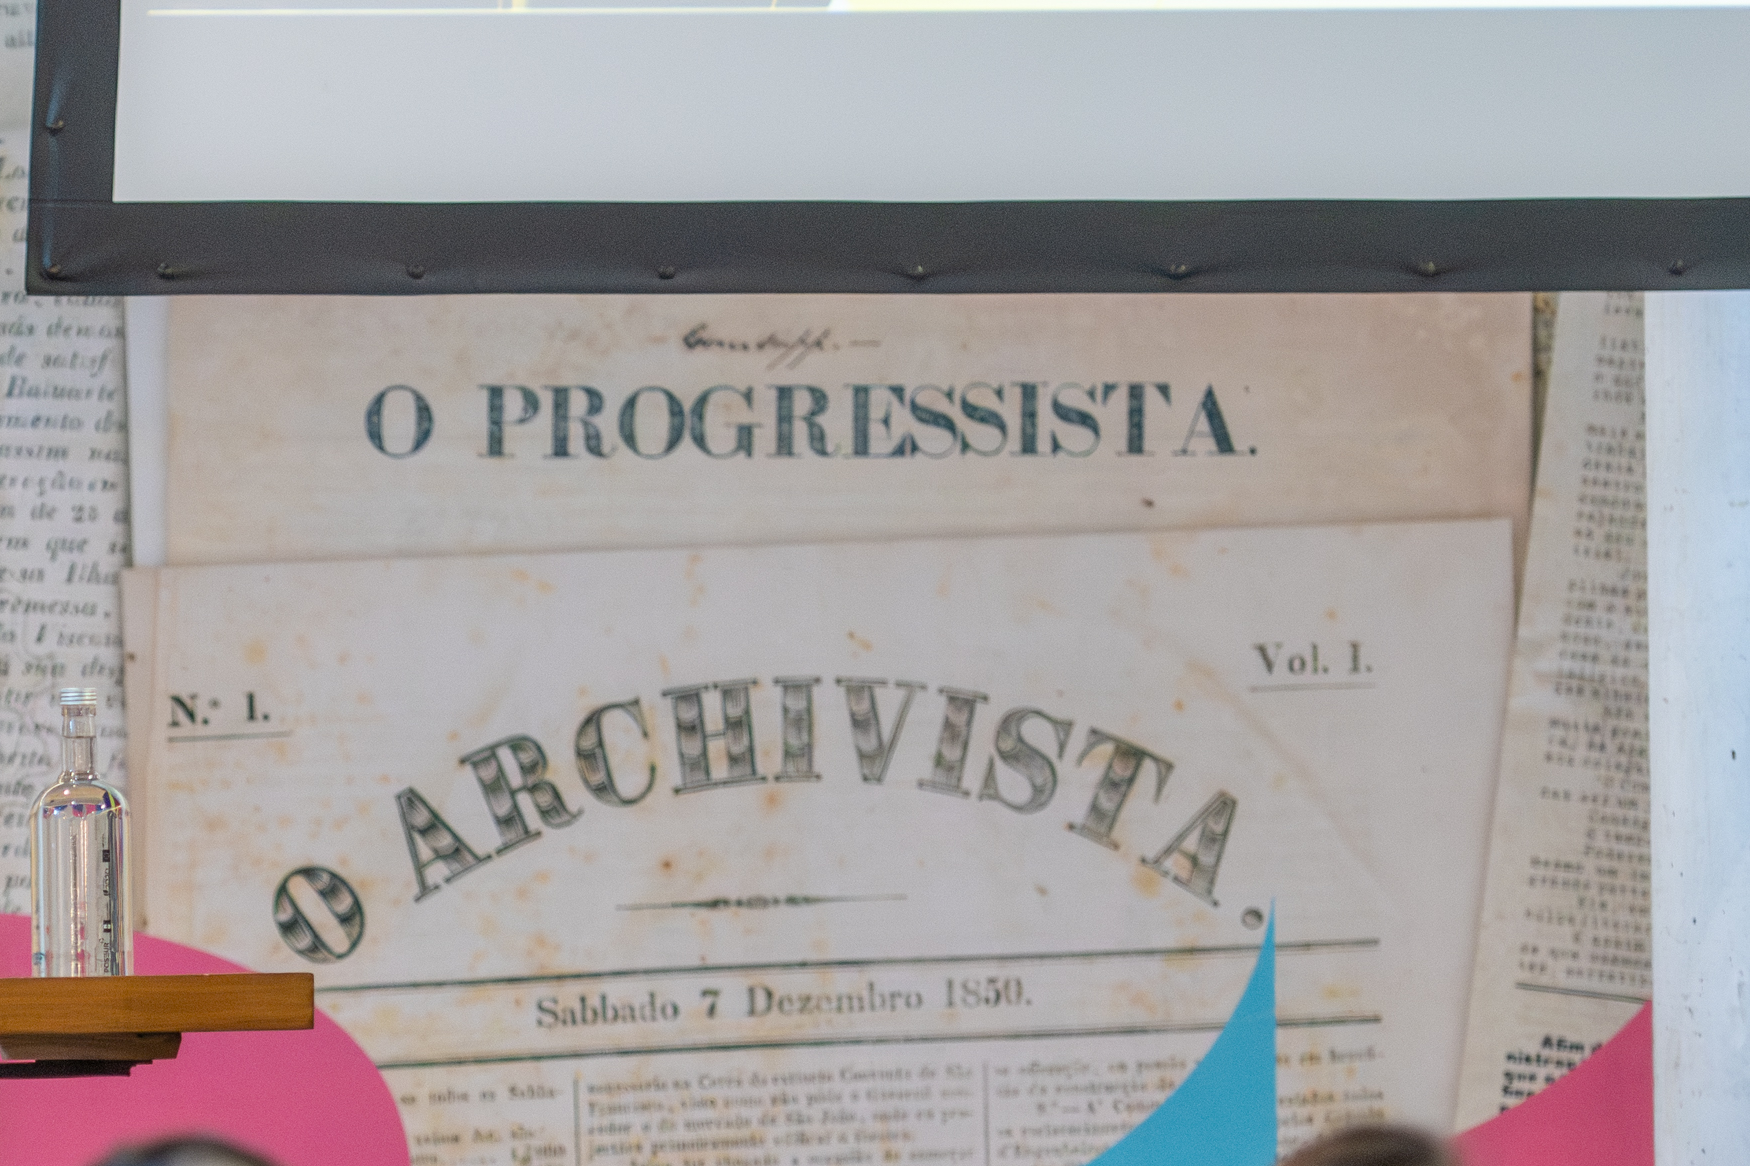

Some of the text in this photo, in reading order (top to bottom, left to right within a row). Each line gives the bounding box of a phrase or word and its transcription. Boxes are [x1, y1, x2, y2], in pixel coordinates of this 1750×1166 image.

[363, 381, 1258, 460] O PROGRESSISTA.
[1252, 639, 1375, 678] Vol. I.
[245, 691, 271, 722] 1.
[272, 864, 366, 963] O
[534, 976, 1033, 1030] Sabbado 7 Dezembro 1850.
